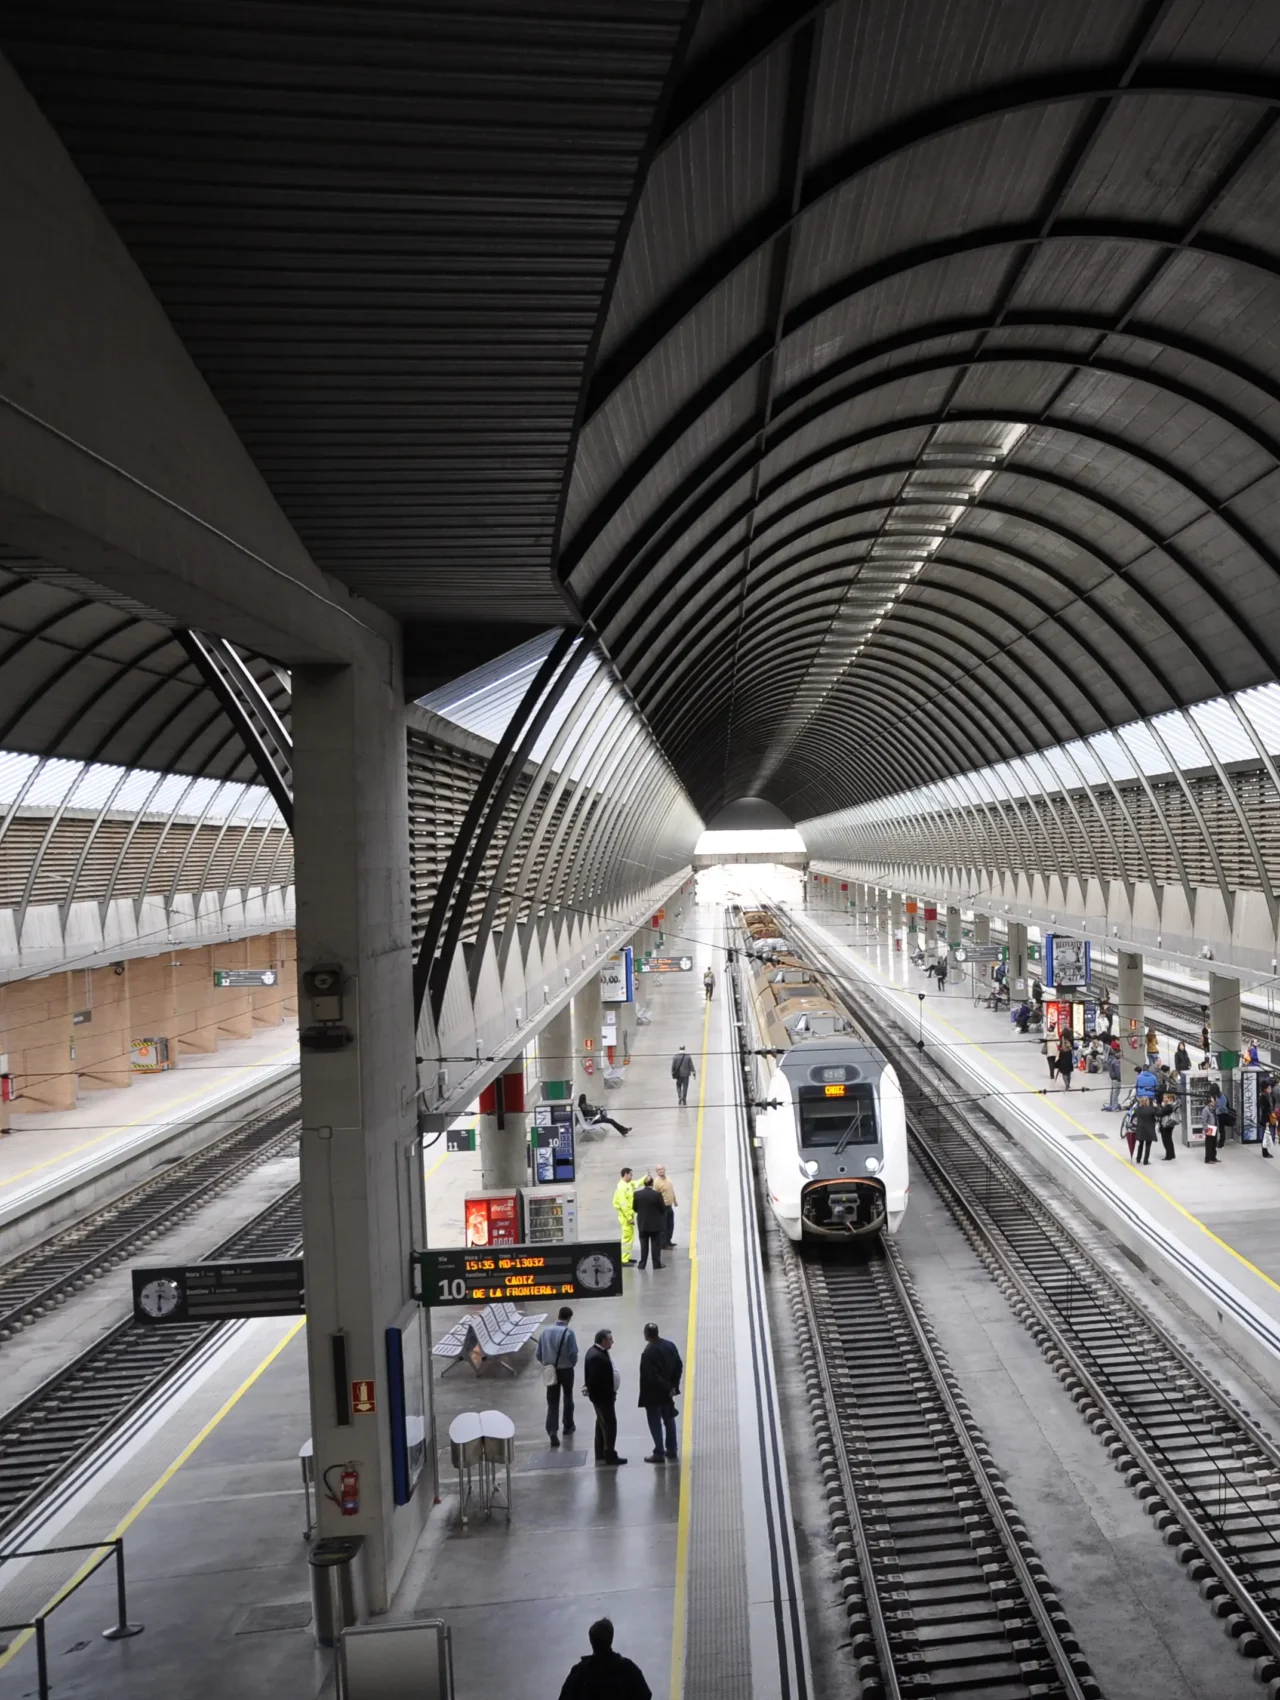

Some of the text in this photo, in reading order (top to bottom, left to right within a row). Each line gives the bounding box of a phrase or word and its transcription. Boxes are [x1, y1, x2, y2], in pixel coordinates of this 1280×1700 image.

[1211, 1057, 1219, 1069] A
[448, 1142, 459, 1151] 11
[548, 1138, 559, 1148] 10
[466, 1260, 494, 1270] 15:35
[505, 1275, 534, 1285] CADIZ
[438, 1279, 466, 1300] 10
[473, 1289, 485, 1298] DE
[490, 1288, 502, 1297] LA
